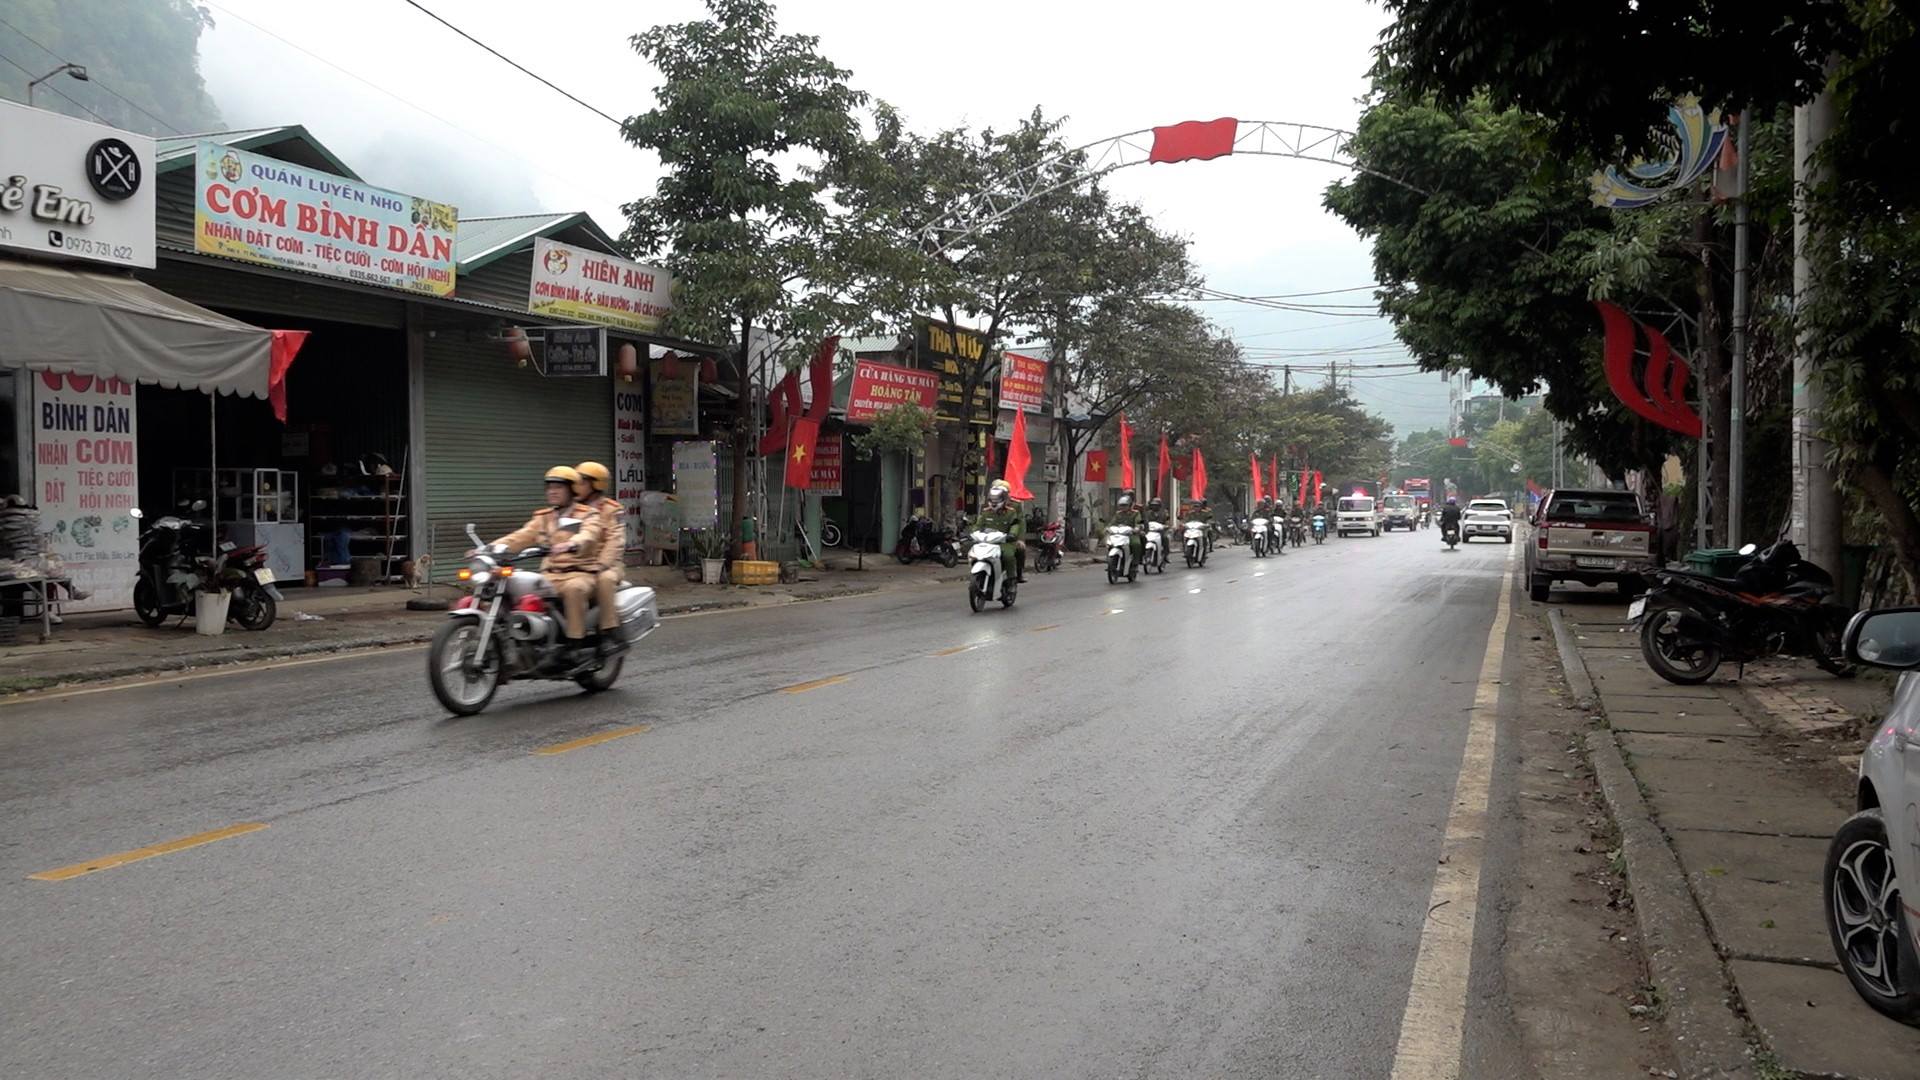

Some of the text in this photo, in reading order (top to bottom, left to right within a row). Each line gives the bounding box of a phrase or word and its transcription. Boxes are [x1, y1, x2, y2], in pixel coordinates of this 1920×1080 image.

[31, 184, 95, 225] Em
[251, 164, 302, 187] QUÁN
[370, 195, 403, 213] NHO
[206, 183, 453, 262] CƠM BÌNH DÂN
[65, 236, 133, 260] 0973 731 622
[204, 221, 242, 243] NHẬN
[246, 228, 272, 250] ĐẶT
[276, 236, 304, 254] CƠM
[314, 243, 341, 263] TIỆC
[344, 249, 371, 268] CƯỚI
[381, 258, 404, 275] CƠM
[407, 261, 425, 280] HỘI
[427, 268, 451, 287] NGHỊ
[623, 268, 656, 293] ANH
[928, 324, 966, 358] THAH
[880, 371, 905, 384] HÀNG
[42, 396, 130, 434] BÌNH DÂN
[38, 438, 68, 470] NHẬN
[76, 438, 134, 465] CƠM
